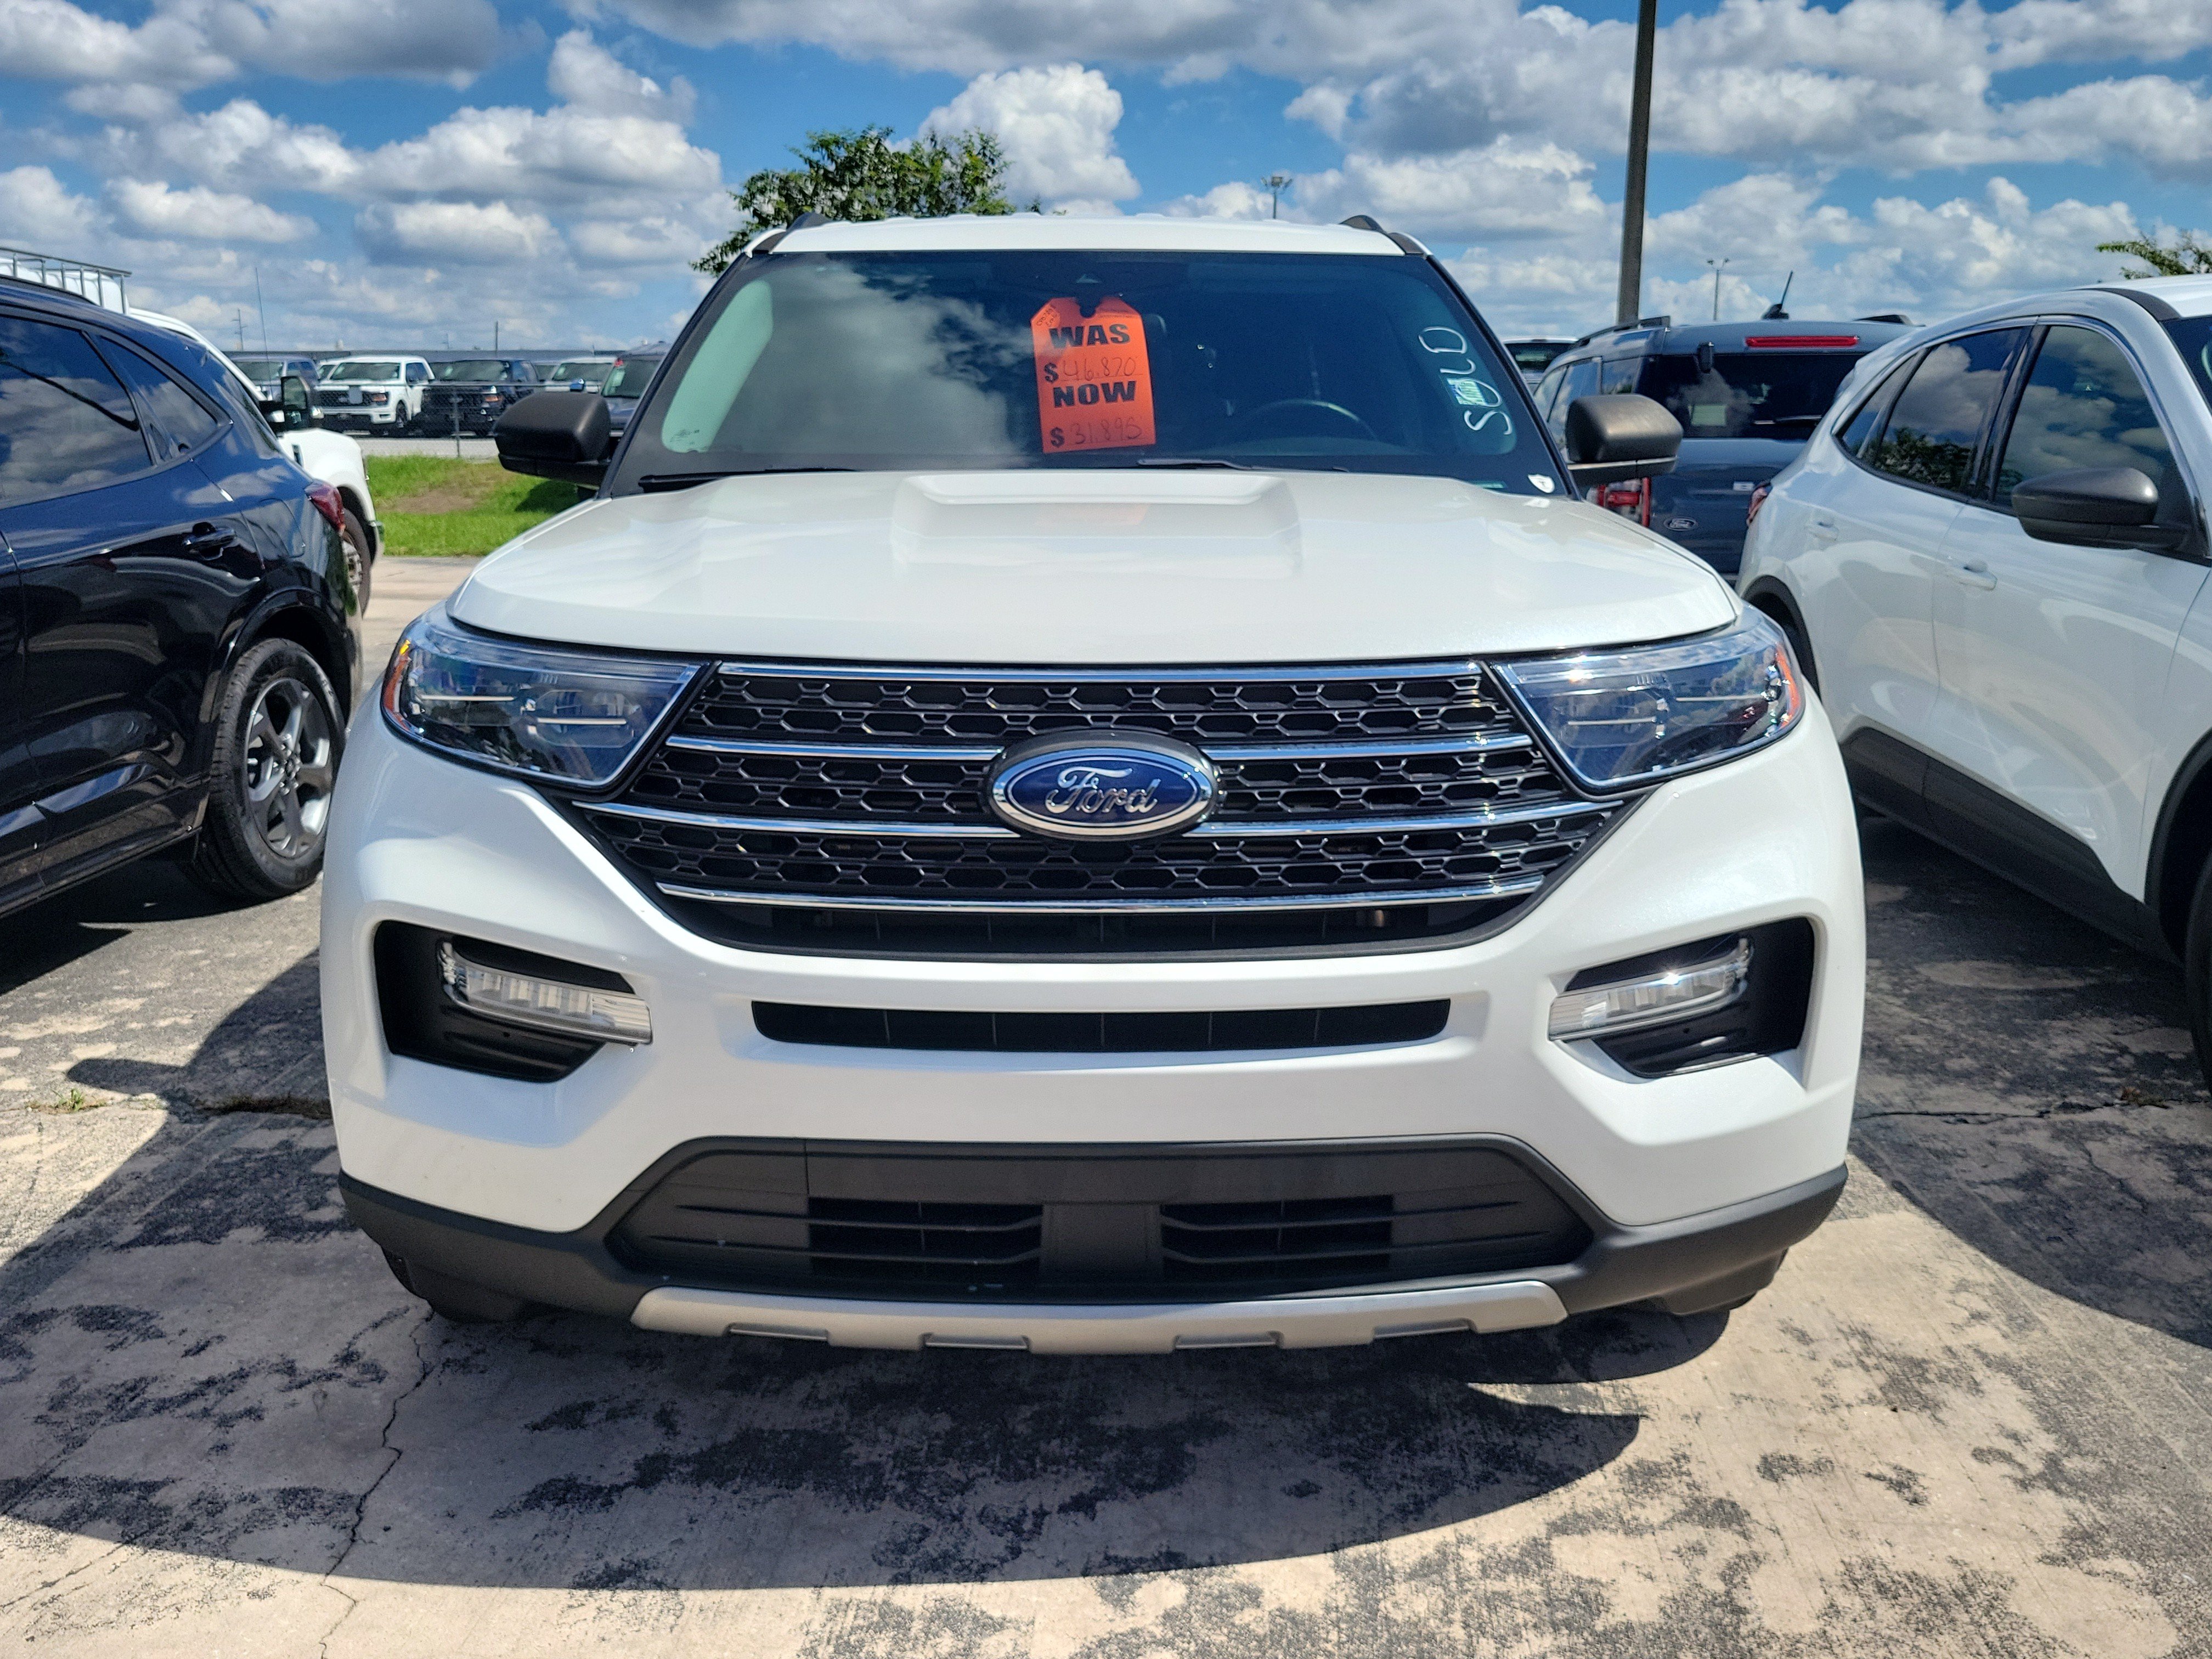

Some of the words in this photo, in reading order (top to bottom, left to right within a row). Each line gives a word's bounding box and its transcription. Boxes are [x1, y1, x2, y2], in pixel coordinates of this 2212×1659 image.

[1048, 324, 1131, 348] WAS
[1053, 380, 1137, 408] NOW
[1045, 766, 1162, 814] Ford
